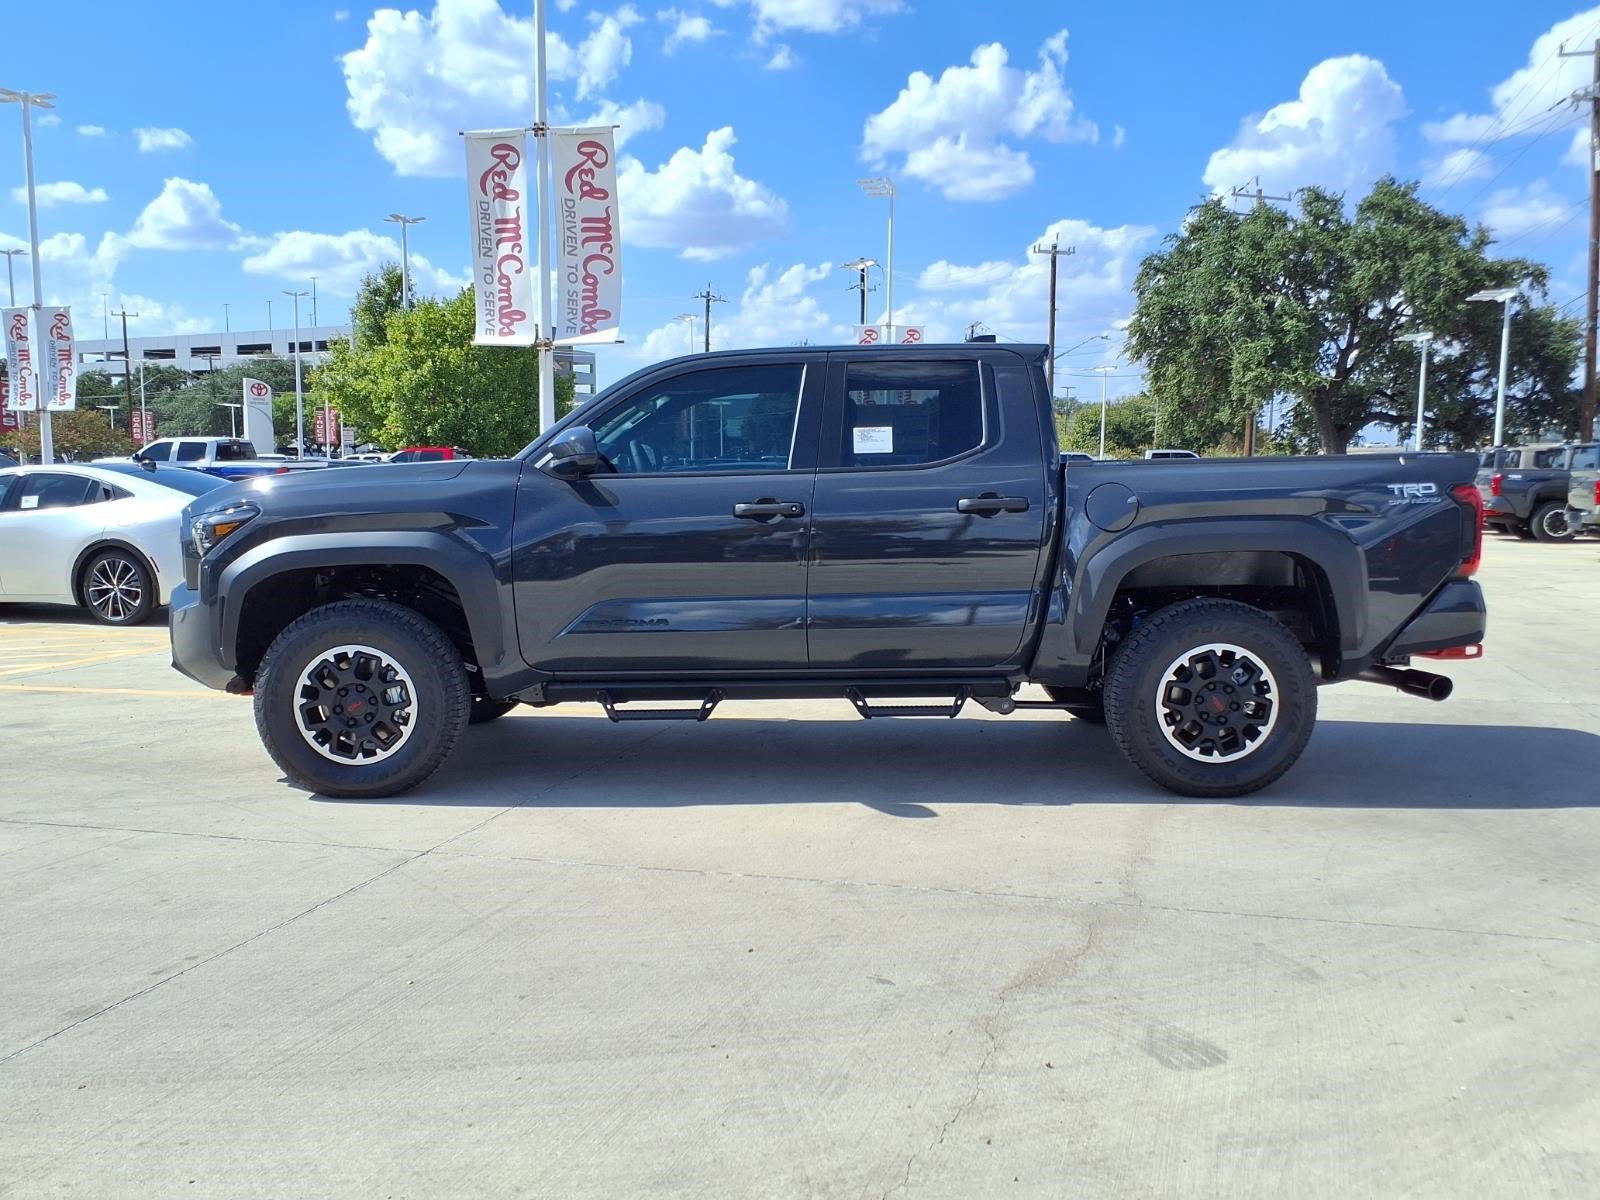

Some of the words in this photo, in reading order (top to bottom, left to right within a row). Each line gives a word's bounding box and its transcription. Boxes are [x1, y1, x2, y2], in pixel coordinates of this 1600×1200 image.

[480, 143, 521, 202] Red
[564, 140, 609, 202] Red
[478, 200, 493, 258] DRIVEN
[564, 198, 579, 257] DRIVEN
[483, 264, 494, 285] TO
[494, 205, 527, 337] McCombs
[567, 263, 579, 285] TO
[580, 205, 614, 336] McCombs
[10, 314, 28, 342] Red
[50, 313, 70, 342] Red
[484, 291, 496, 337] SERVE
[566, 290, 579, 335] SERVE
[1387, 483, 1436, 498] TRD
